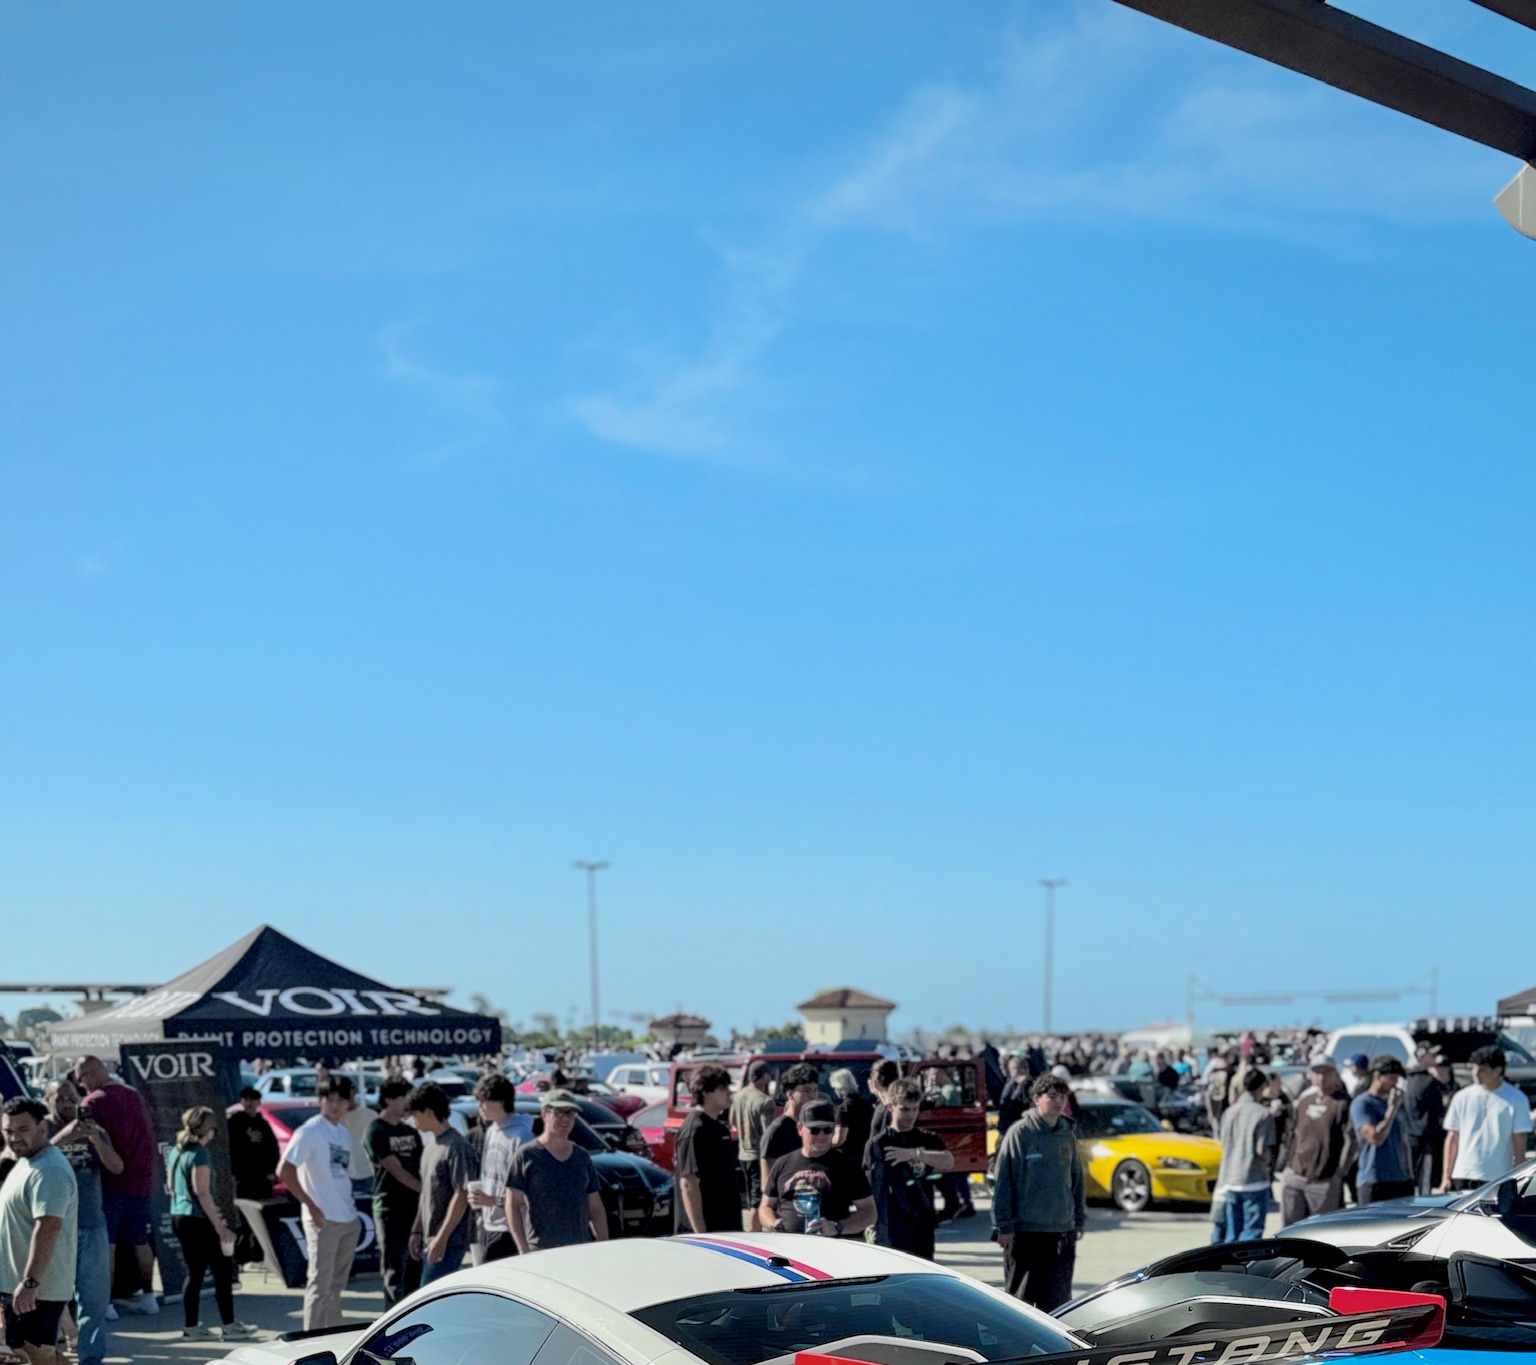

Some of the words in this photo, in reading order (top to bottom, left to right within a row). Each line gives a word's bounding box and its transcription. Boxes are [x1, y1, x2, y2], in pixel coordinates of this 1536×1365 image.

[212, 987, 441, 1016] VOIR
[243, 1030, 363, 1047] PROTECTION
[371, 1028, 492, 1046] TECHNOLOGY
[129, 1053, 216, 1080] VOIR
